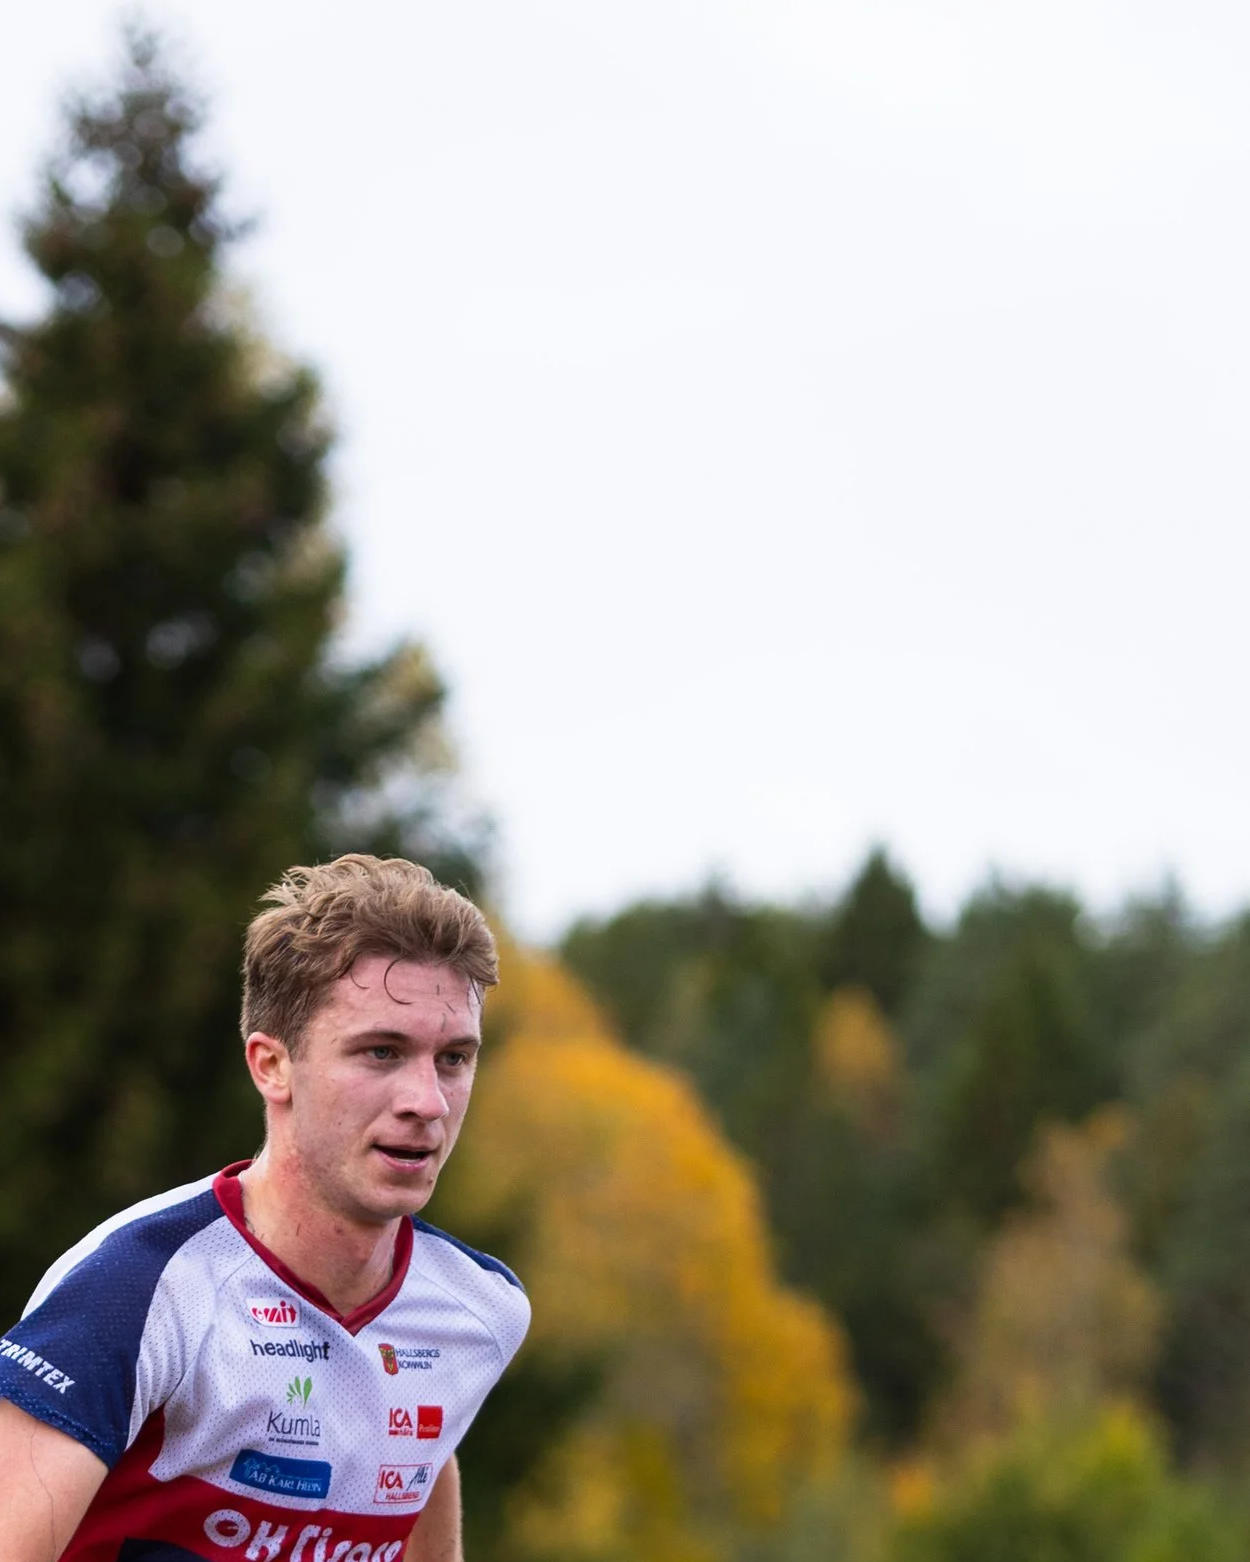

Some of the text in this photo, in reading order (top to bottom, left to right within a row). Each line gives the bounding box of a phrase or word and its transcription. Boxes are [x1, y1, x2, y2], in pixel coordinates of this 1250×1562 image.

[250, 1339, 330, 1363] headlight
[395, 1348, 441, 1358] HALLSBERGS
[266, 1411, 321, 1438] Kumla
[389, 1407, 413, 1428] ICA
[379, 1470, 404, 1490] ICA
